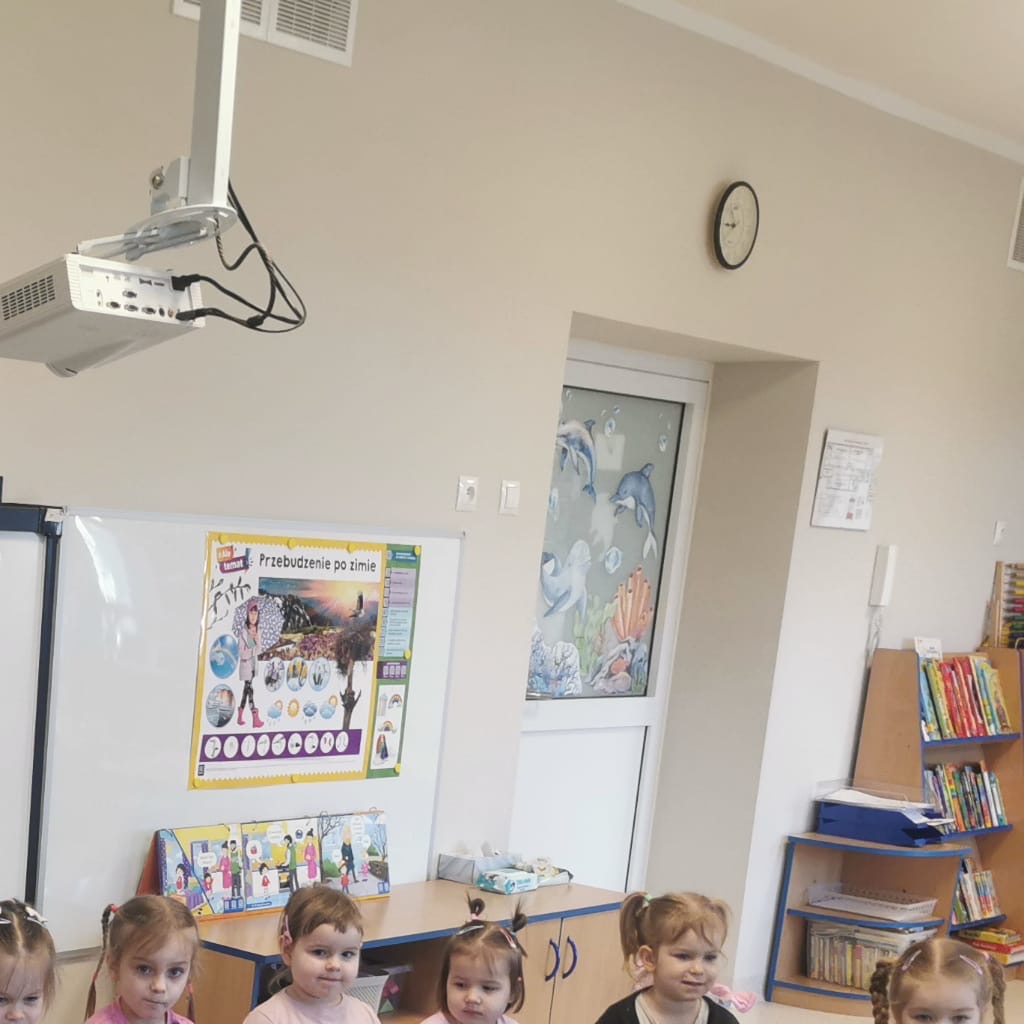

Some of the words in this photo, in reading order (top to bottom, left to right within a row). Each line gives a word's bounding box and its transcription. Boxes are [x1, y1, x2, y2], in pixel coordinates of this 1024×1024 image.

[259, 553, 331, 570] Przebudzenie
[334, 559, 347, 573] po
[350, 558, 377, 573] zimie
